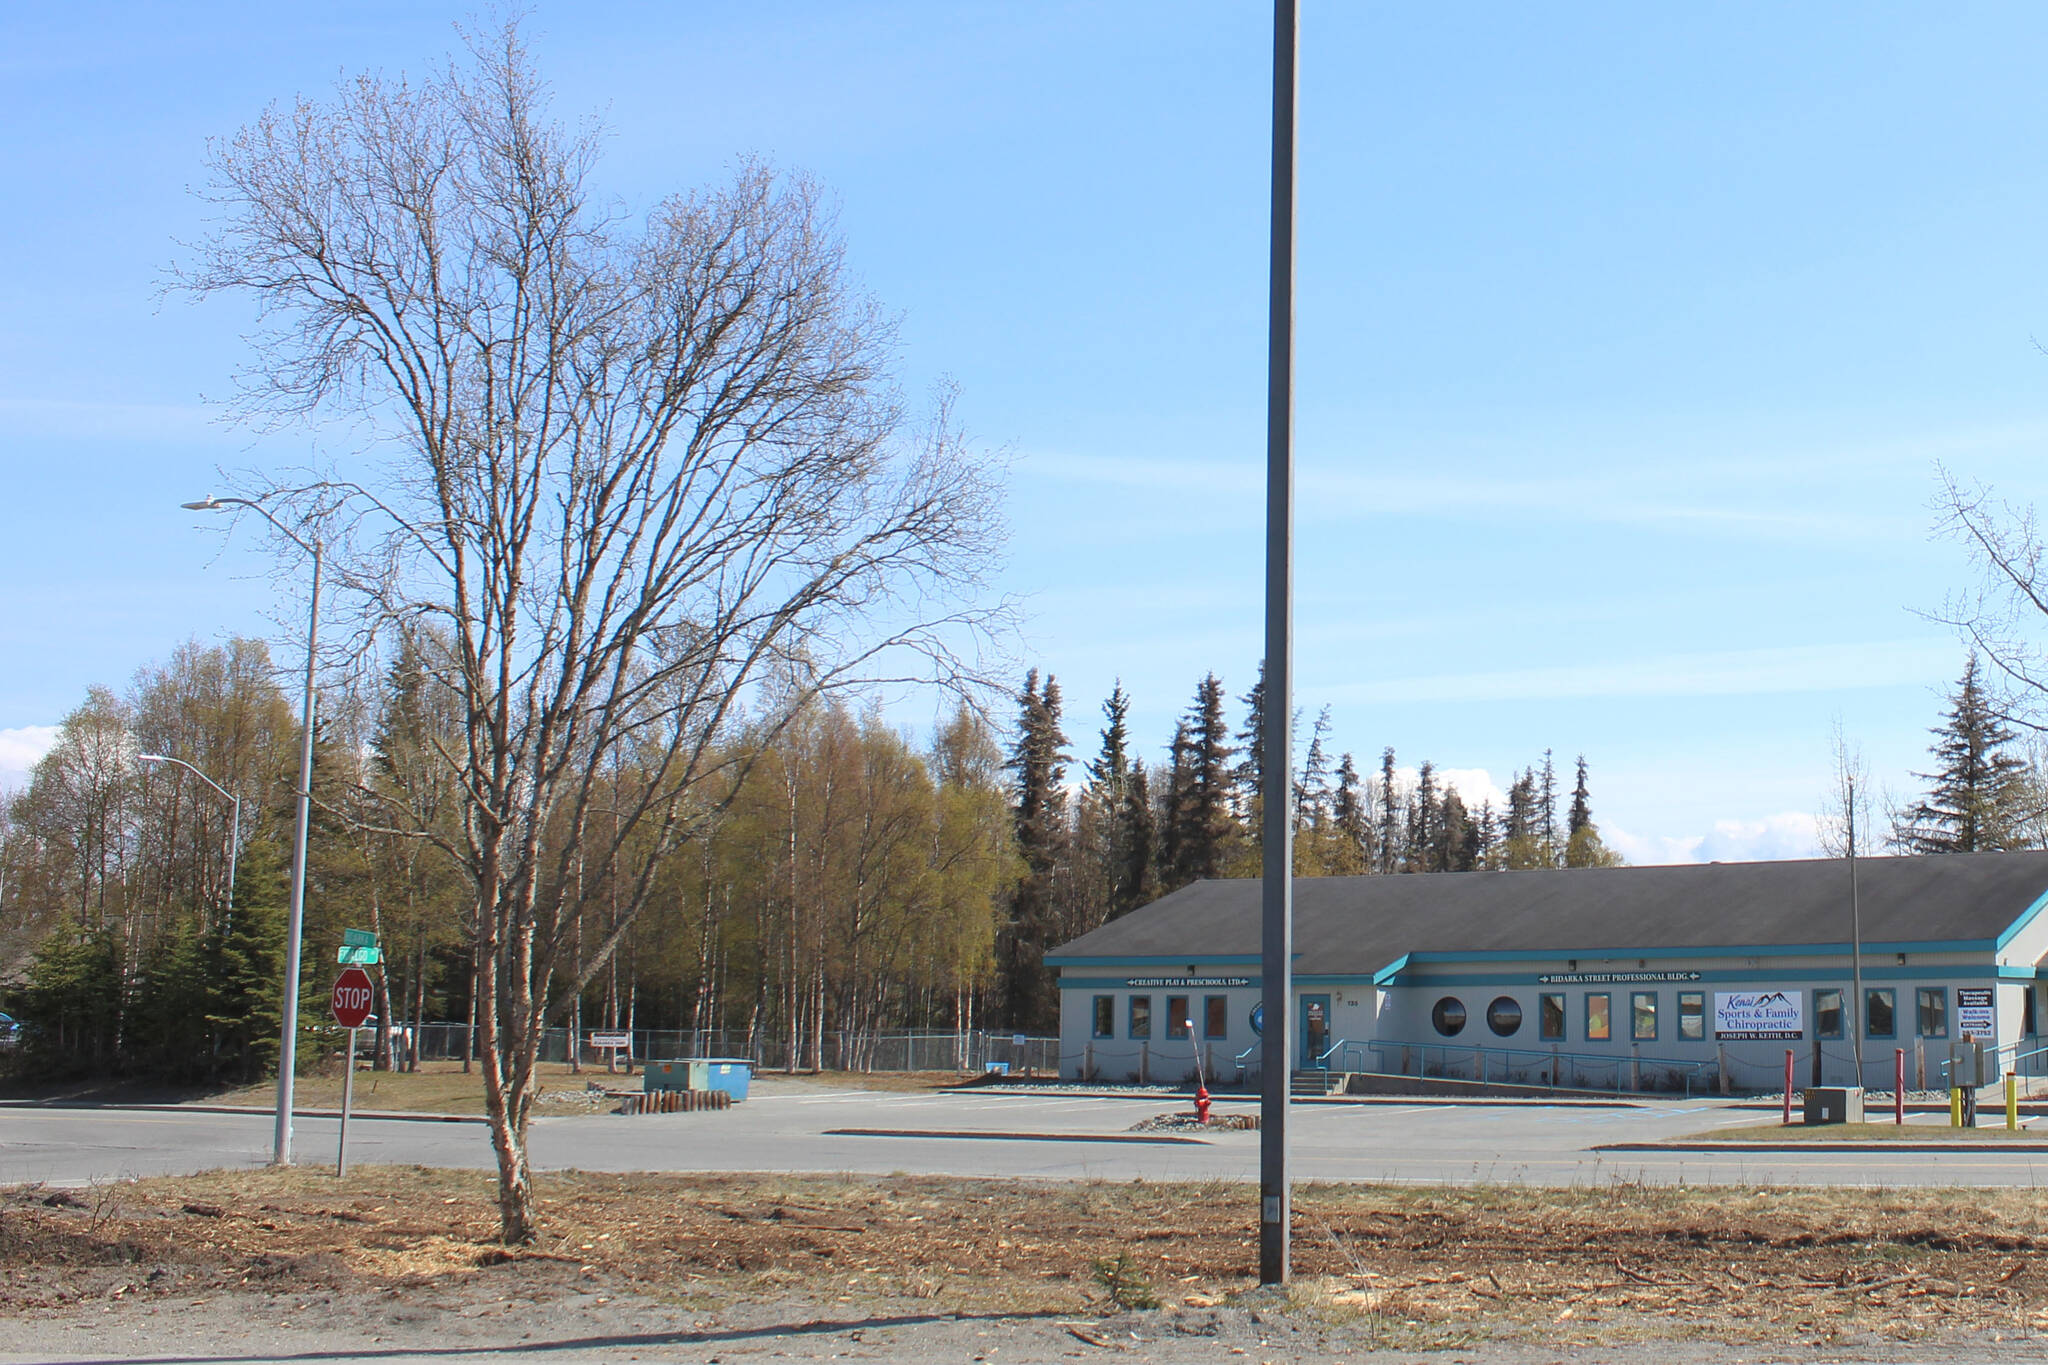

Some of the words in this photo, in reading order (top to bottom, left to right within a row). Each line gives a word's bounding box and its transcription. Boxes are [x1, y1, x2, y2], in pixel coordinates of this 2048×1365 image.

[1134, 978, 1163, 986] CREATIVE
[1165, 978, 1180, 986] PLAY
[1550, 975, 1583, 983] BIDARKA
[1584, 974, 1610, 982] STREET
[1612, 973, 1666, 982] PROFESSIONAL
[1667, 972, 1687, 980] BLDG.
[335, 987, 370, 1009] STOP
[1727, 994, 1755, 1009] Kenai
[1718, 1008, 1751, 1020] Sports
[1754, 1009, 1762, 1018] &
[1765, 1008, 1799, 1020] Family
[1727, 1019, 1792, 1030] Chiropractic
